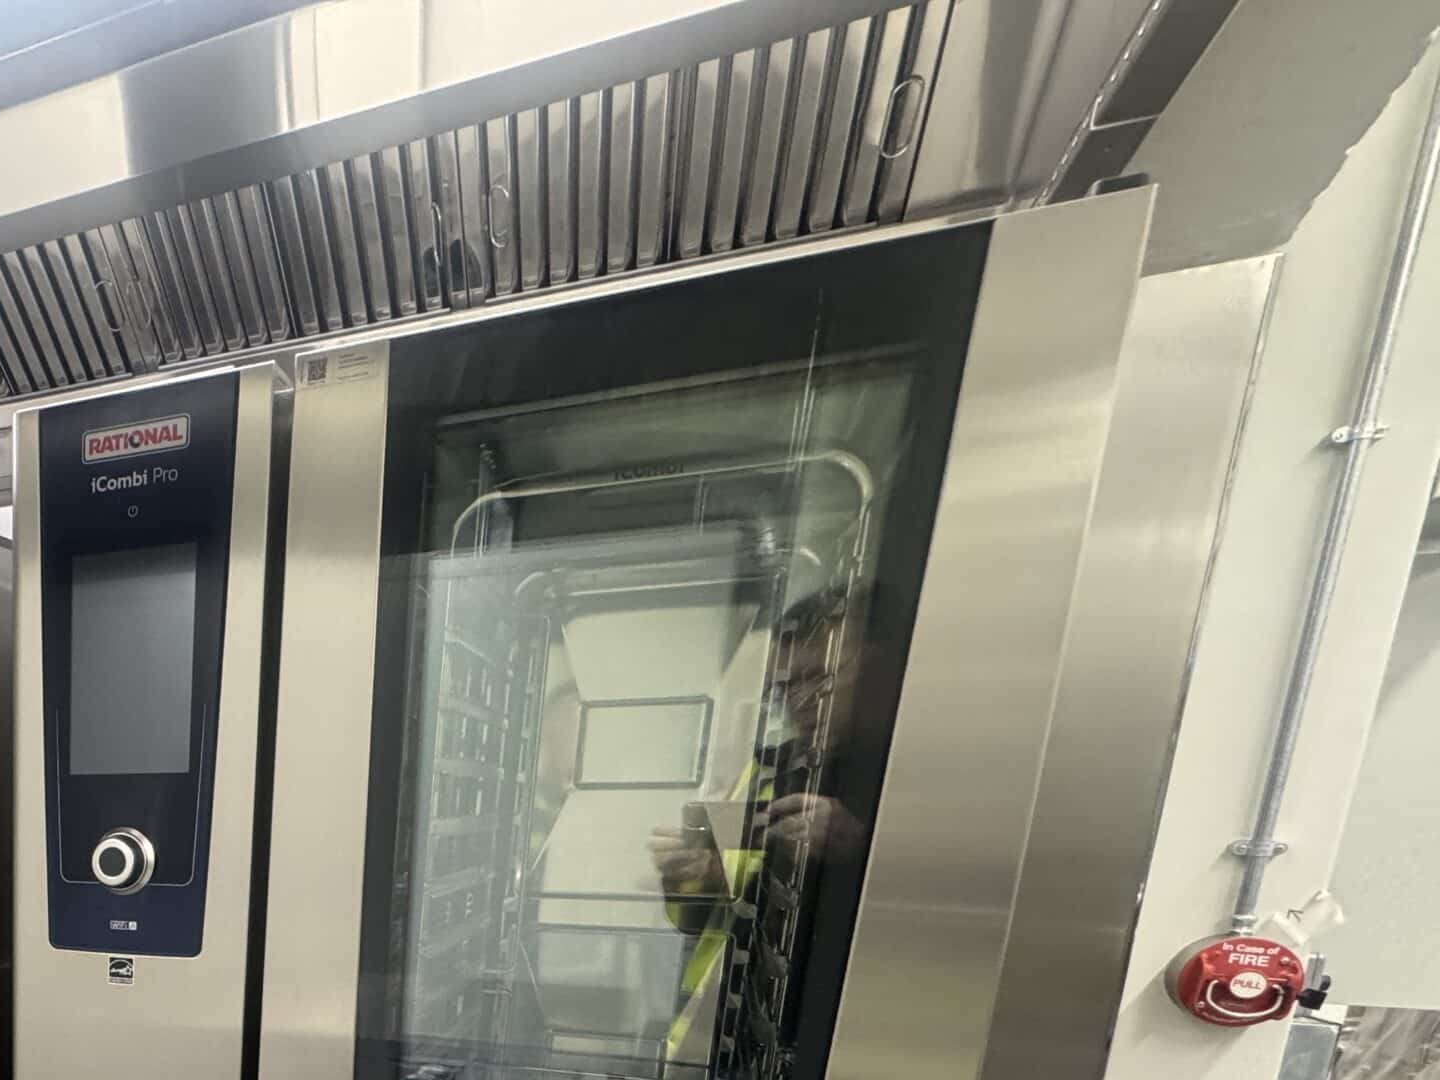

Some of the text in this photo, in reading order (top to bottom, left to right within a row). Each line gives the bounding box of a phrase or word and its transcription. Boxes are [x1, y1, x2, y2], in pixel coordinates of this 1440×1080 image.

[88, 423, 184, 456] RATIONAL
[91, 467, 178, 494] iCombi Pro
[1222, 942, 1280, 955] In Case of
[1228, 952, 1271, 967] FIRE
[1232, 978, 1262, 990] PULL
